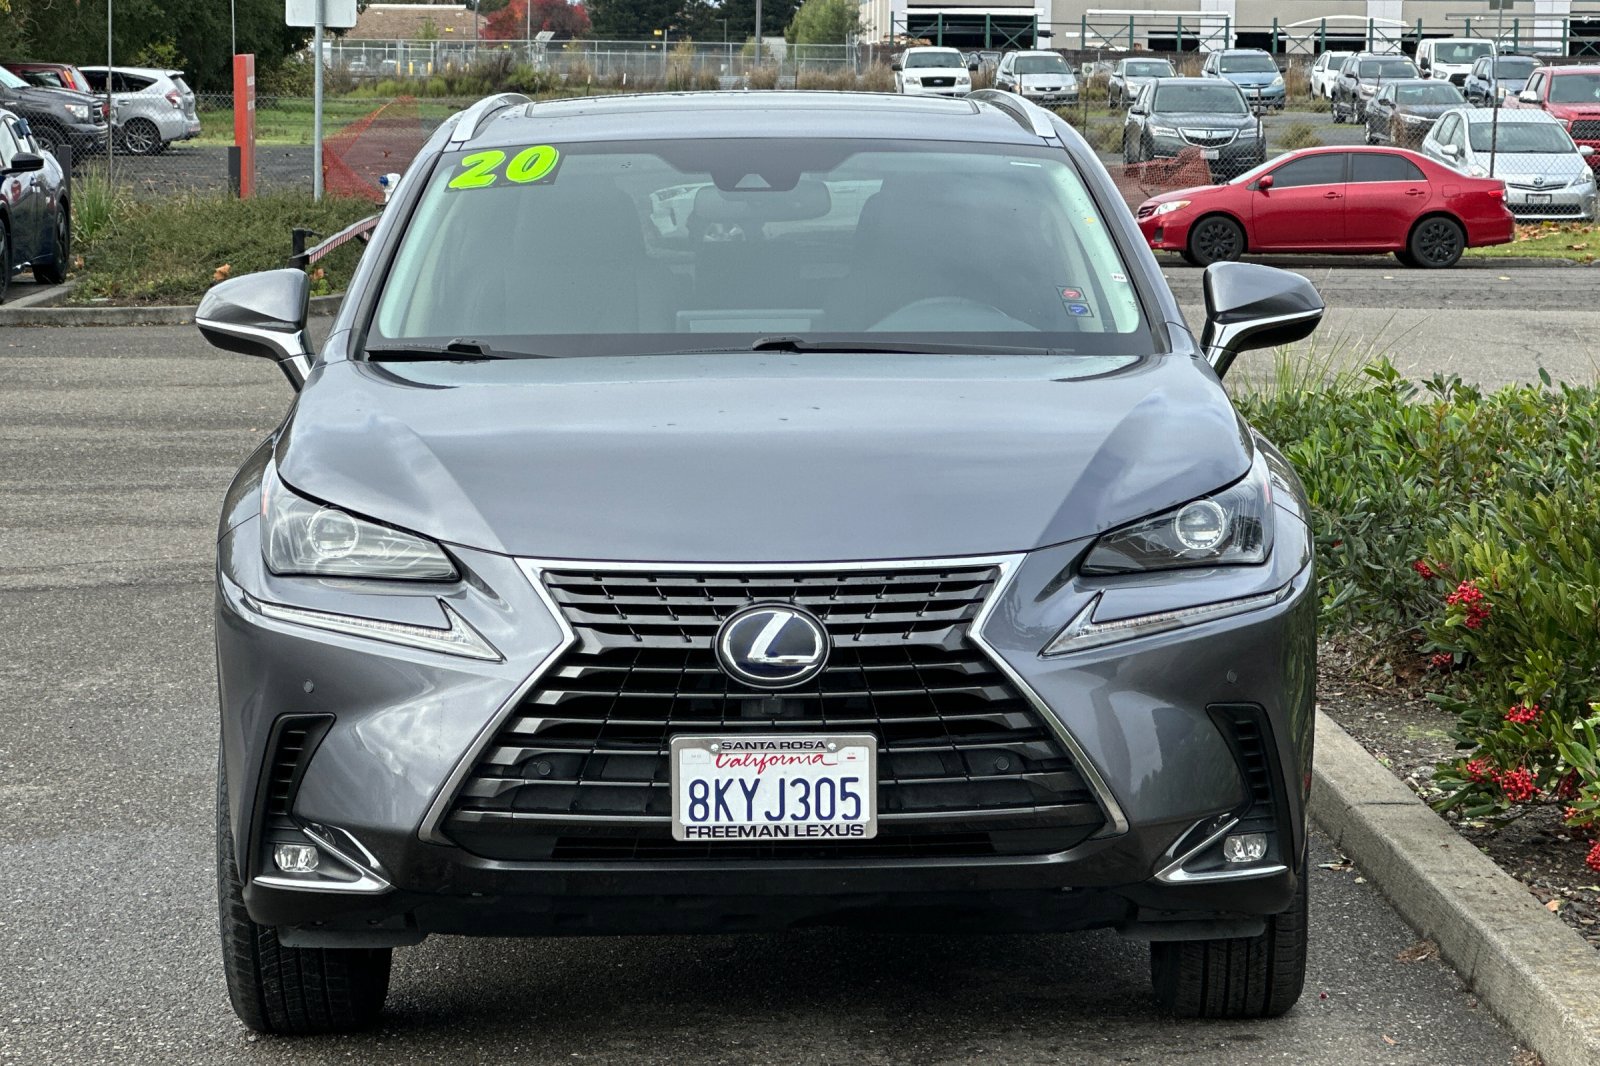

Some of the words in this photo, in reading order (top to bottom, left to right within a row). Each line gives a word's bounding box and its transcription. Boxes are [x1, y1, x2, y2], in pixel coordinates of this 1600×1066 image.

[449, 145, 560, 189] 20
[721, 741, 775, 750] SANTA
[779, 740, 826, 750] ROSA
[715, 752, 838, 775] California
[688, 777, 861, 822] 8KYJ305
[685, 825, 790, 839] FREEMAN
[794, 824, 864, 838] LEXUS
